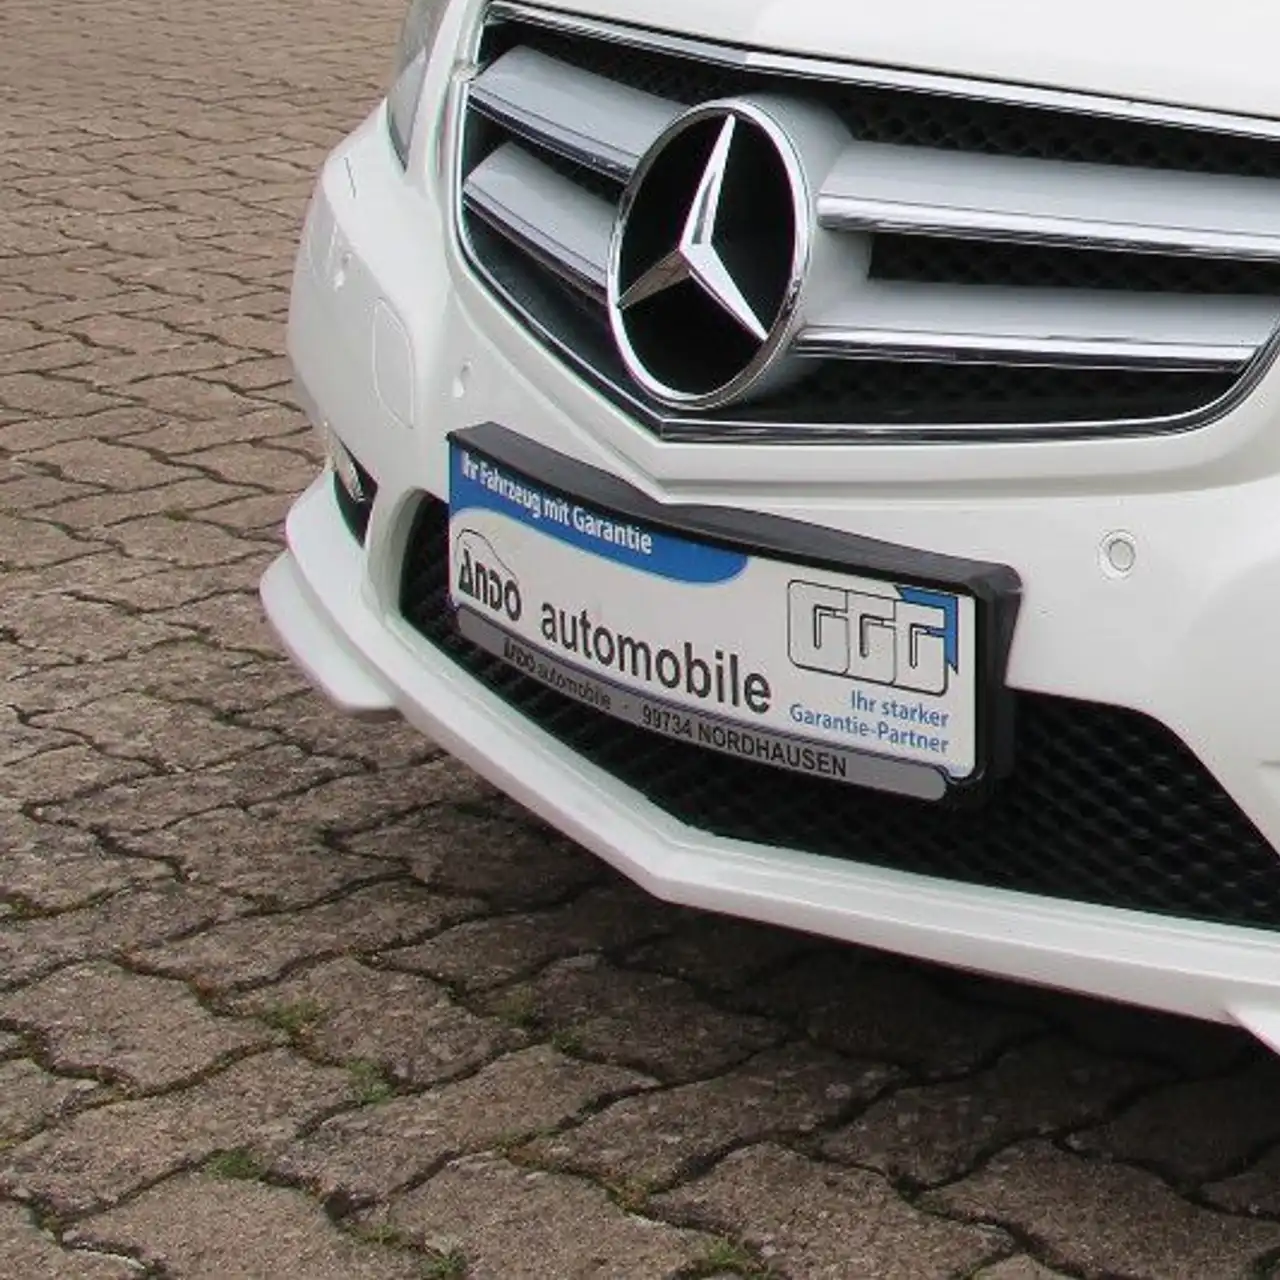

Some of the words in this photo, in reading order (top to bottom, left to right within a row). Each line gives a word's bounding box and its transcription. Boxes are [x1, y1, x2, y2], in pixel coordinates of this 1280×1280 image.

[461, 452, 480, 480] Ihr
[480, 462, 541, 518] Fahrzeug
[543, 497, 570, 524] mit
[573, 506, 653, 555] Garantie
[458, 547, 522, 622] ANDO
[540, 601, 772, 714] automobile
[537, 664, 612, 711] automobile
[642, 704, 693, 739] 99734
[698, 722, 847, 778] NORDHAUSEN
[789, 703, 950, 754] Garantie-Partner
[851, 689, 875, 713] Ihr
[881, 698, 950, 728] starker
